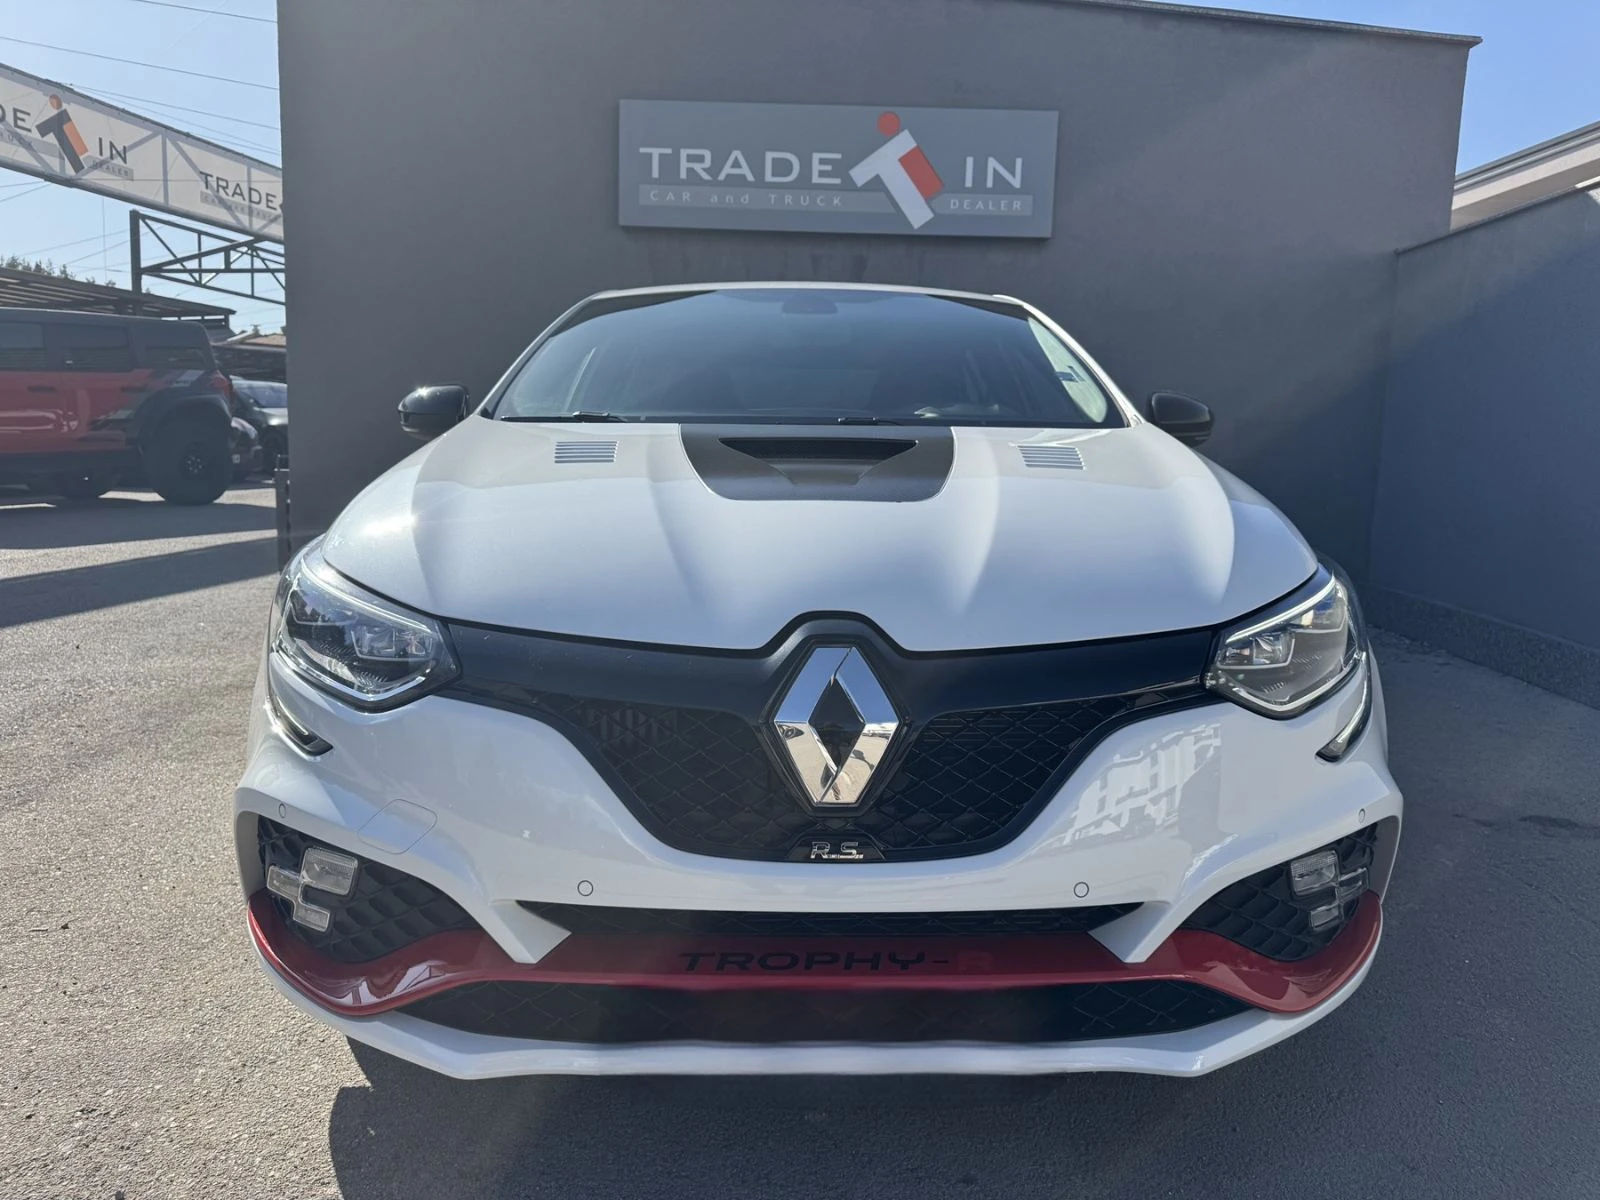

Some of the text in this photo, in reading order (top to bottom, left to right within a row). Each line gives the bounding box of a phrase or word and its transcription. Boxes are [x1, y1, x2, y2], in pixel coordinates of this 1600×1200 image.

[98, 137, 128, 165] IN
[639, 147, 843, 184] TRADE
[964, 156, 1023, 189] IN
[199, 170, 278, 211] TRADE
[650, 189, 842, 207] CAR and TRUCK
[950, 199, 1022, 212] DEALER
